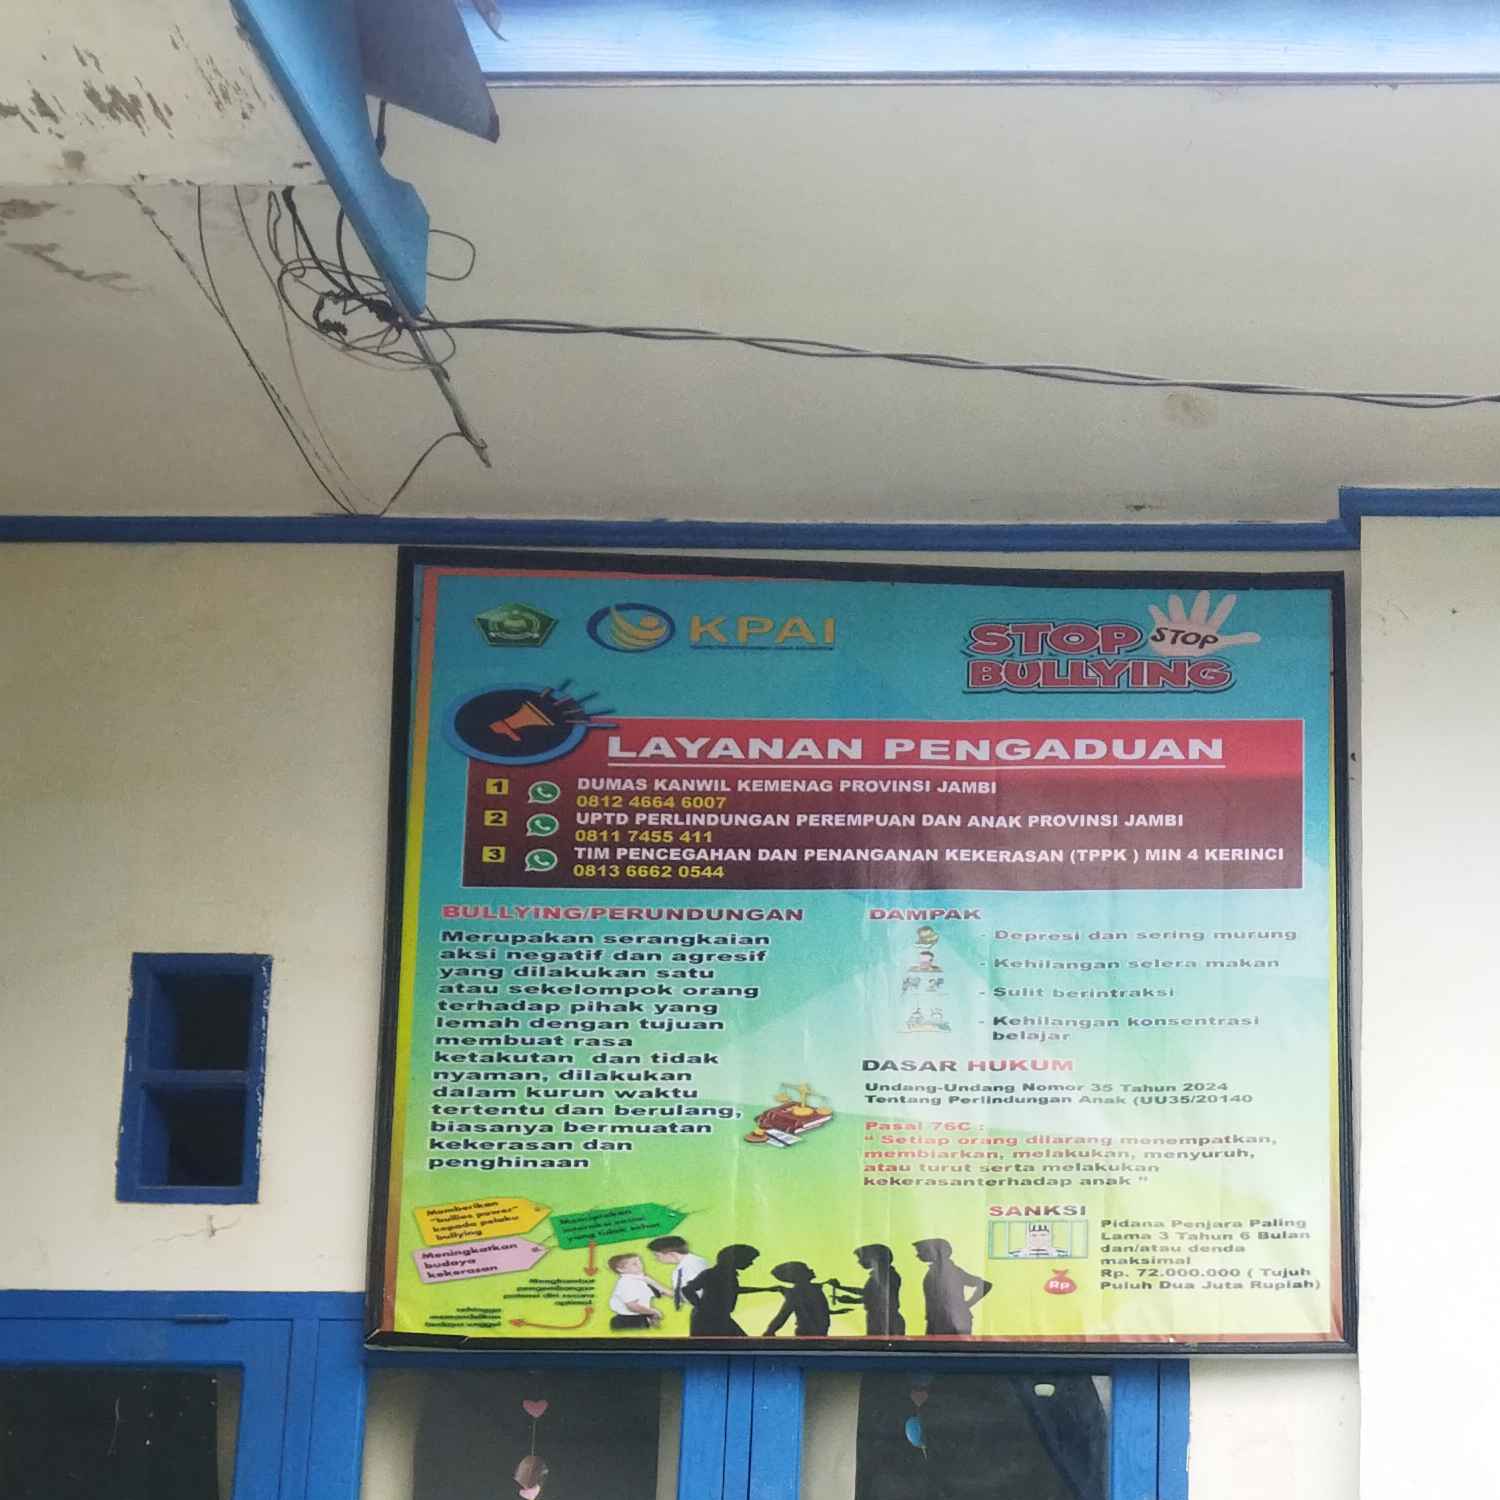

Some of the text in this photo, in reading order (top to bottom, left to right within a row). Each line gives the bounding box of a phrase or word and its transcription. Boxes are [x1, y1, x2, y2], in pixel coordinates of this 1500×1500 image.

[689, 615, 836, 645] KPAI
[968, 622, 1143, 656] STOP
[1151, 627, 1218, 649] STOP
[966, 659, 1232, 690] BULLYING
[608, 736, 1223, 760] LAYANAN PENGADUAN
[491, 778, 996, 794] 1 DUMAS KANWIL KEMENAG PROVINSI JAMBI
[576, 796, 726, 809] 0812 4664 6007
[489, 812, 1184, 828] 2 UPTD PERLINDUNGAN PEREMPUAN DAN ANAK PROVINSI JAMBI
[575, 830, 712, 843] 0811 7455 411
[488, 848, 502, 861] 3
[574, 848, 610, 860] TIM
[616, 848, 752, 861] PENCEGAHAN
[759, 848, 796, 861] DAN
[802, 848, 938, 862] PENANGANAN
[945, 849, 1064, 862] KEKERASAN
[1145, 848, 1181, 862] MIN
[1187, 848, 1198, 861] 4
[1205, 848, 1284, 861] KERINCI
[574, 865, 724, 878] 0813 6662 0544
[870, 909, 981, 920] DAMPAK
[441, 931, 770, 947] Merupakan serangkaian
[440, 948, 767, 964] aksi negatif dan agresif
[439, 966, 715, 979] yang dilakukan satu
[438, 984, 759, 999] atau sekelompok orang
[993, 987, 1176, 999] Sulit berintraksi
[438, 1001, 718, 1015] terhadap pihak yang
[437, 1018, 724, 1032] lemah dengan tujuan
[993, 1016, 1260, 1029] Kehilangan konsentrasi
[435, 1035, 633, 1047] membuat rasa
[993, 1030, 1071, 1043] belajar
[434, 1052, 719, 1065] ketakutan dan tidak
[862, 1059, 1073, 1072] DASAR HUKUM
[433, 1069, 692, 1083] nyaman, dilakukan
[432, 1086, 699, 1099] dalam kurun waktu
[865, 1082, 1228, 1094] Undang-Undang Nomor 35 Tahun 2024
[865, 1095, 942, 1106] Tentang
[949, 1095, 1072, 1106] Perlindungan
[1079, 1095, 1126, 1105] Anak
[432, 1103, 741, 1119] tertentu dan berulang,
[430, 1121, 712, 1135] biasanya bermuatan
[429, 1138, 632, 1151] kekerasan dan
[428, 1155, 589, 1170] penghinaan
[989, 1206, 1086, 1217] SANKSI
[1101, 1218, 1307, 1230] Pidana Penjara Paling
[1101, 1243, 1245, 1253] dan/atau denda
[1101, 1256, 1191, 1265] maksimal
[1101, 1267, 1310, 1279] Rp. 72.000.000 Tujuh
[1050, 1281, 1069, 1291] Rp
